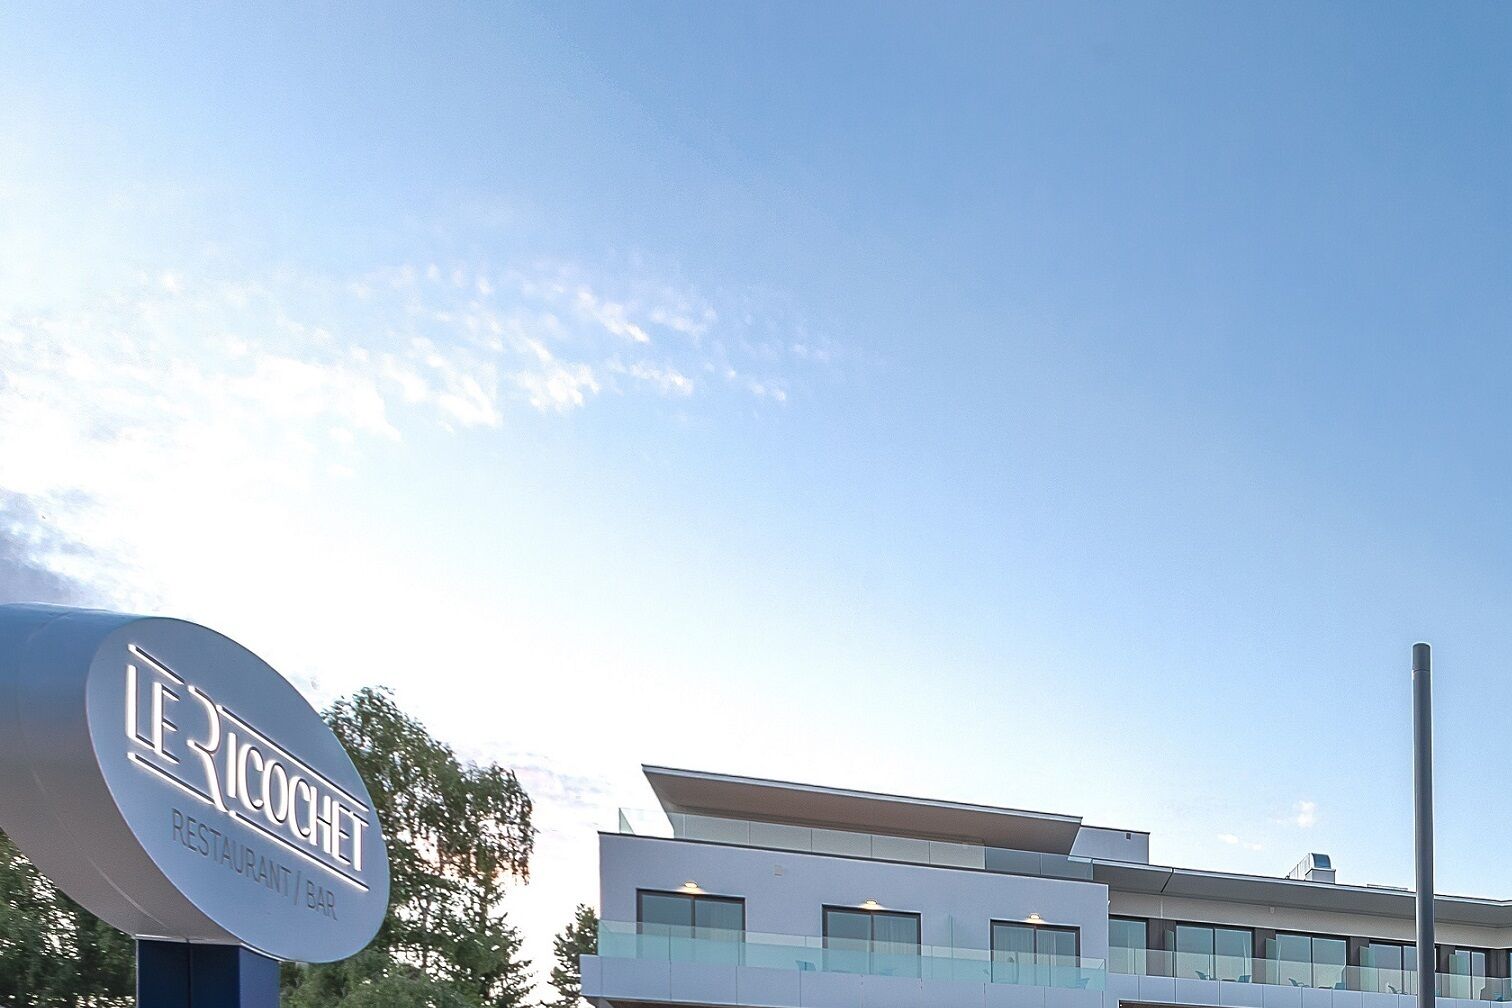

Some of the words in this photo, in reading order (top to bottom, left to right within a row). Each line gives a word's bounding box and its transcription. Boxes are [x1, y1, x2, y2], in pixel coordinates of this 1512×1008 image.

[125, 662, 182, 766] LE
[187, 684, 370, 872] RICOCHET
[171, 807, 293, 897] RESTAURANT
[306, 878, 339, 922] BAR
